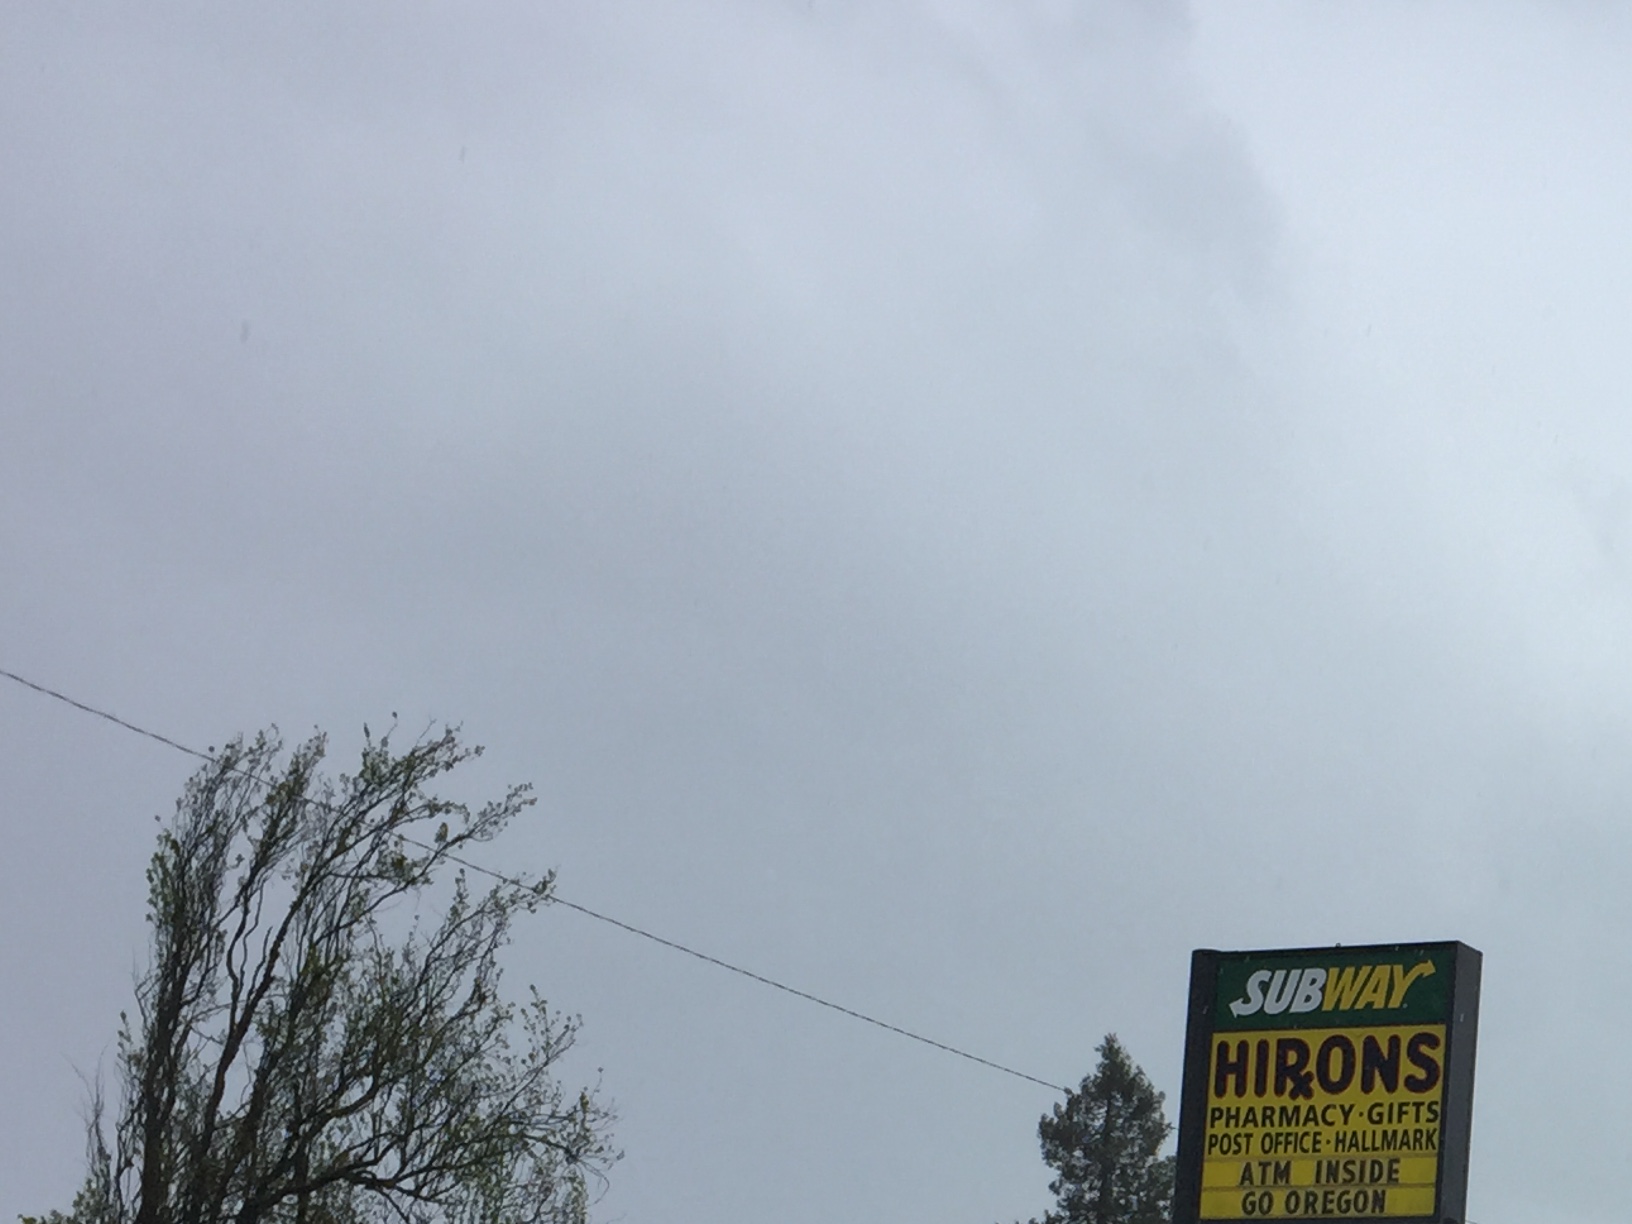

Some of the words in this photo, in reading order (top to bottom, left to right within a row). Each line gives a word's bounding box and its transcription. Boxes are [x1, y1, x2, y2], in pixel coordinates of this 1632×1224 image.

[1229, 960, 1436, 1018] SUBWAY
[1213, 1031, 1441, 1100] HIRONS
[1209, 1104, 1356, 1129] PHARMACY
[1367, 1101, 1440, 1125] GIFTS
[1208, 1133, 1254, 1155] POST
[1261, 1131, 1323, 1155] OFFICE
[1334, 1129, 1438, 1153] HALLMARK
[1239, 1160, 1292, 1185] ATM
[1315, 1158, 1400, 1184] INSIDE
[1241, 1191, 1275, 1216] GO
[1285, 1189, 1387, 1215] OREGON
